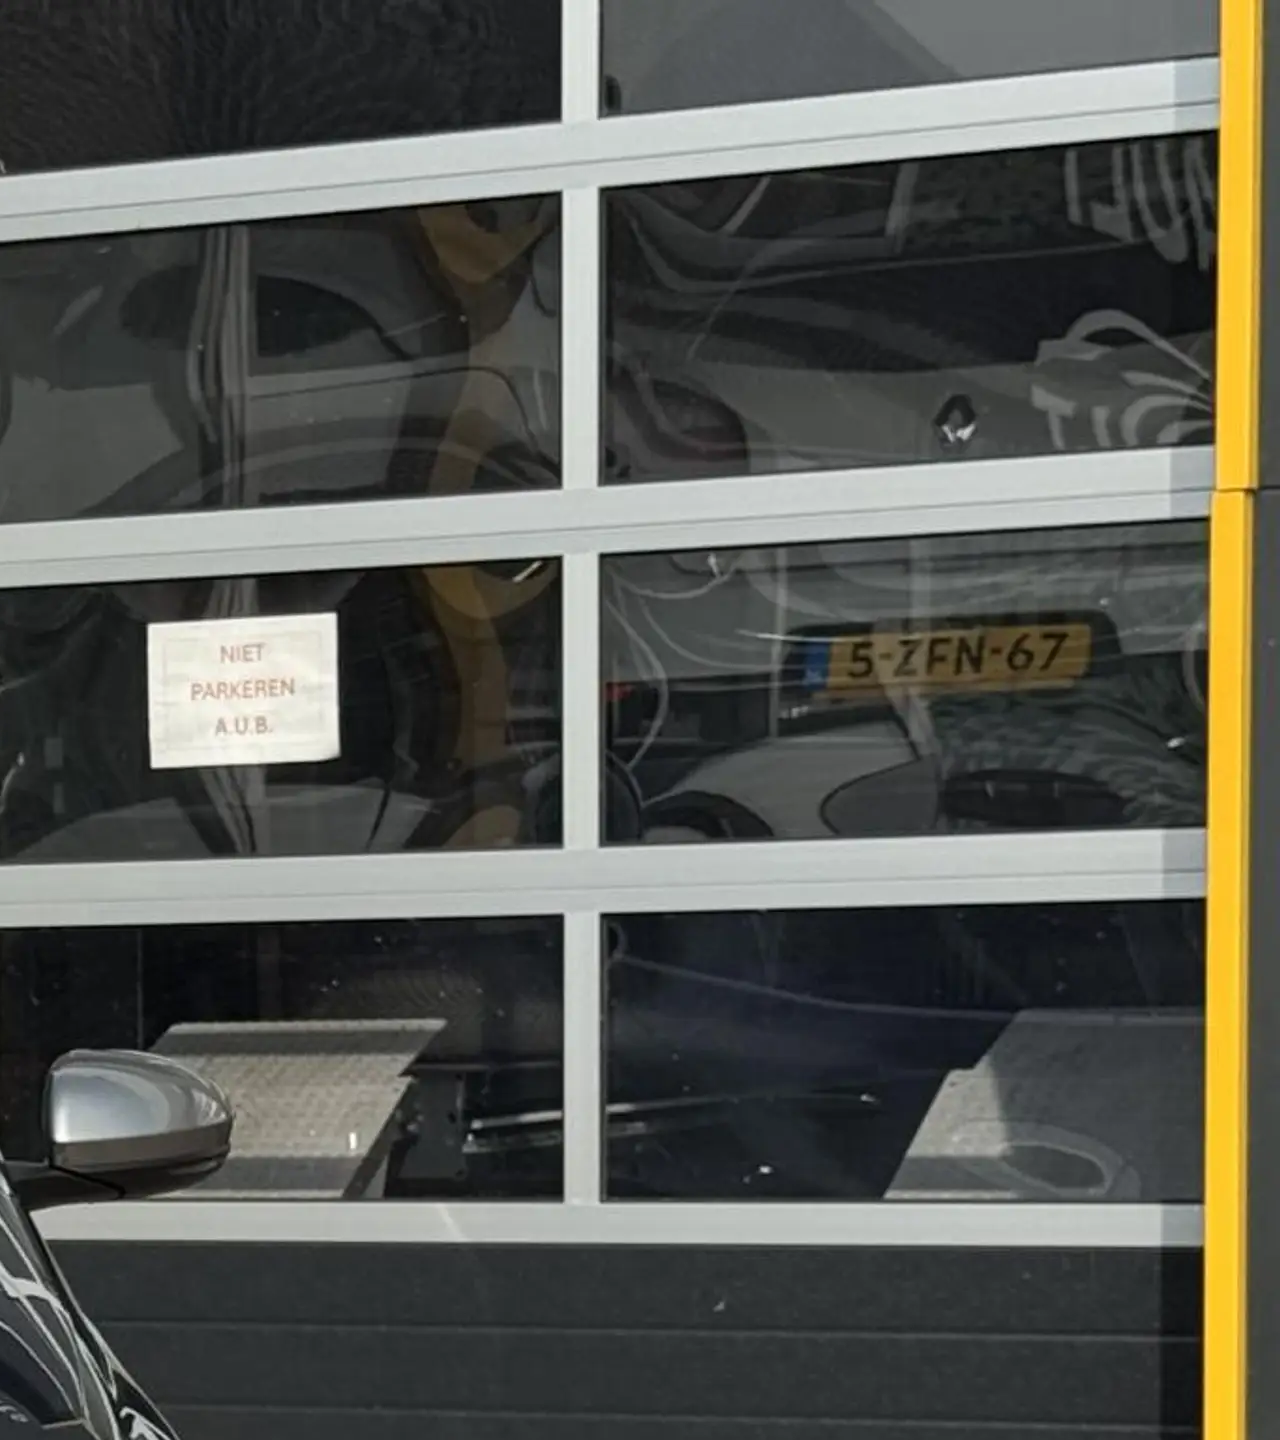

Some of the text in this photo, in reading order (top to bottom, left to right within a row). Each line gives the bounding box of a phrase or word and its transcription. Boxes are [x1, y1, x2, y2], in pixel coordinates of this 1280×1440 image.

[220, 642, 266, 664] NIET
[847, 632, 1070, 680] 5-ZFN-67
[190, 678, 296, 702] PARKEREN
[215, 715, 273, 736] A.U.B.
